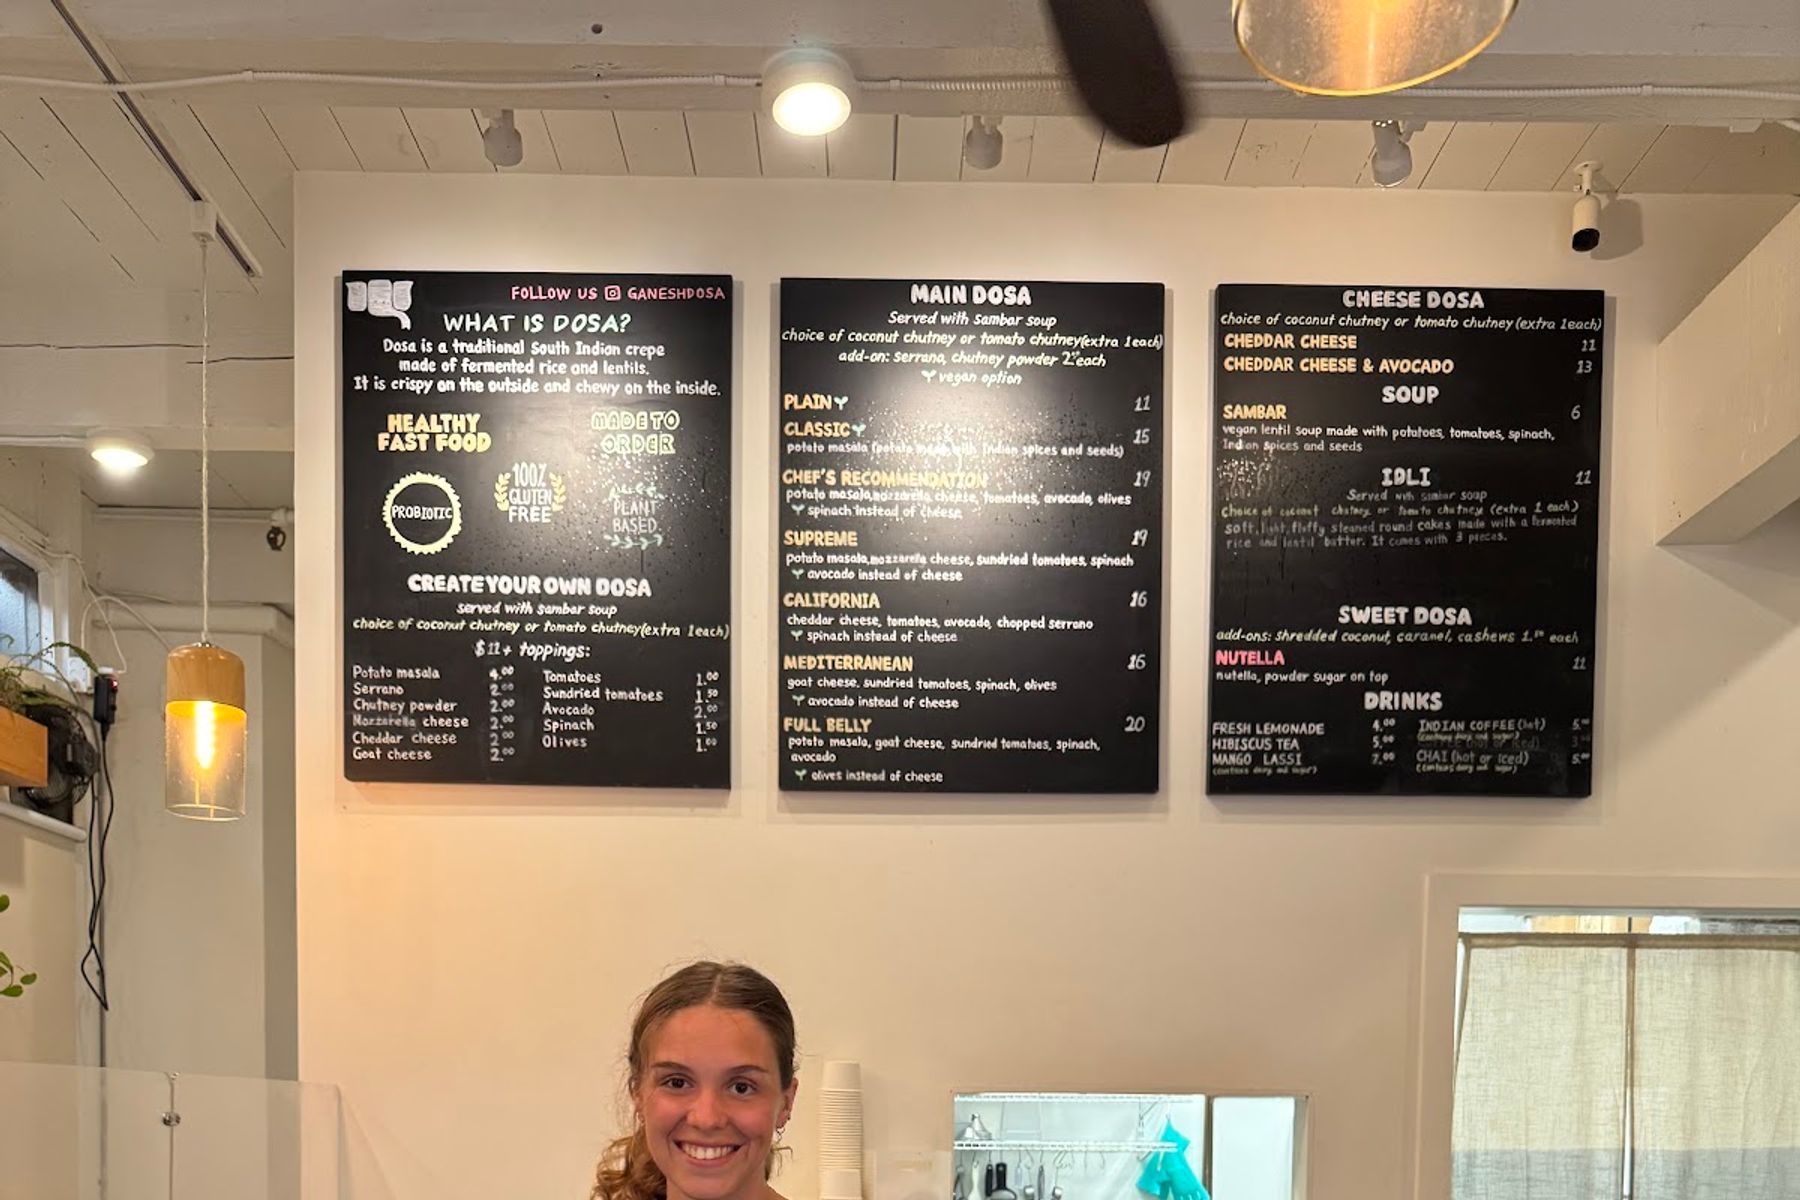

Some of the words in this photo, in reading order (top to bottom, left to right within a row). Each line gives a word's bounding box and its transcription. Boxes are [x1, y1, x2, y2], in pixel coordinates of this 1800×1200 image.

[512, 286, 571, 300] FOLLOW
[578, 288, 597, 299] US
[628, 287, 725, 300] GANESHDOSA
[911, 284, 967, 303] MAIN
[973, 285, 1031, 305] DOSA
[1343, 290, 1420, 308] CHEESE
[1427, 291, 1484, 308] DOSA
[444, 313, 515, 332] WHAT
[524, 314, 543, 333] IS
[554, 314, 630, 333] DOSA?
[888, 311, 938, 324] Served
[941, 311, 969, 325] with
[1025, 316, 1056, 330] soup
[383, 339, 416, 352] Dosa
[421, 338, 432, 353] is
[438, 343, 448, 353] a
[452, 338, 524, 355] traditional
[531, 341, 570, 355] South
[575, 341, 620, 356] Indian
[625, 345, 665, 360] crepe
[1225, 334, 1294, 348] CHEDDAR
[1301, 335, 1356, 348] CHEESE
[1582, 339, 1596, 351] 11
[399, 358, 436, 372] made
[441, 357, 458, 372] of
[461, 358, 535, 374] fermented
[539, 360, 567, 374] rice
[571, 360, 597, 375] and
[603, 360, 649, 375] lentils.
[1224, 357, 1293, 371] CHEDDAR
[1300, 358, 1356, 372] CHEESE
[1363, 358, 1373, 372] &
[1379, 359, 1453, 373] AVOCADO
[1577, 360, 1592, 373] 13
[354, 375, 368, 390] It
[374, 376, 386, 390] is
[391, 377, 433, 394] crispy
[437, 380, 455, 392] on
[459, 377, 484, 392] the
[488, 377, 539, 393] outside
[544, 378, 570, 394] and
[575, 379, 620, 397] chewy
[625, 383, 642, 395] on
[646, 380, 670, 394] the
[676, 380, 720, 395] inside.
[940, 373, 977, 387] vegan
[981, 371, 1022, 387] option
[785, 394, 831, 410] PLAIN
[1382, 386, 1439, 403] SOUP
[1135, 395, 1150, 411] 11
[1223, 405, 1286, 419] SAMBAR
[1571, 405, 1580, 419] 6
[388, 413, 480, 435] HEALTHY
[589, 411, 647, 433] MADE
[650, 410, 680, 430] TO
[785, 422, 850, 437] CLASSIC
[1133, 429, 1149, 444] 15
[1223, 426, 1257, 437] vegan
[1262, 424, 1290, 435] lentil
[1296, 426, 1322, 438] soup
[1327, 425, 1358, 436] made
[1363, 425, 1388, 436] with
[1393, 425, 1444, 440] potatoes,
[1508, 428, 1554, 442] spinach,
[378, 432, 429, 451] FAST
[436, 432, 491, 452] FOOD
[599, 432, 675, 456] ORDER
[1263, 440, 1299, 456] spices
[1304, 440, 1324, 451] and
[1329, 441, 1362, 452] seeds
[512, 461, 547, 487] 100%
[783, 468, 836, 485] CHEF'S
[842, 468, 989, 490] RECOMMENDATION
[1134, 471, 1150, 486] 19
[1382, 468, 1430, 486] IDLI
[1575, 470, 1591, 485] 11
[509, 489, 552, 505] GLUTEN
[390, 503, 452, 521] PROBIOTIC
[507, 506, 553, 523] FREE
[611, 499, 658, 516] PLANT
[612, 516, 657, 534] BASED
[784, 531, 857, 546] SUPREME
[1132, 530, 1148, 546] 19
[808, 568, 855, 579] avocado
[859, 568, 900, 580] instead
[904, 569, 918, 580] of
[922, 569, 963, 581] cheese
[408, 574, 484, 593] CREATE
[485, 575, 541, 594] YOUR
[544, 577, 590, 595] OWN
[596, 578, 651, 596] DOSA
[784, 593, 880, 608] CALIFORNIA
[1130, 592, 1146, 607] 16
[457, 602, 501, 614] served
[505, 601, 533, 614] with
[537, 602, 585, 615] sambar
[588, 605, 617, 618] soup
[1339, 606, 1408, 624] SWEET
[1415, 607, 1471, 625] DOSA
[787, 613, 834, 625] cheddar
[944, 616, 992, 629] avocado,
[997, 616, 1045, 631] chopped
[1049, 620, 1093, 629] serrano
[520, 642, 590, 662] toppings:
[1216, 650, 1284, 665] NUTELLA
[784, 655, 913, 671] MEDITERRANEAN
[1128, 655, 1145, 669] 16
[1573, 657, 1585, 669] 11
[353, 665, 392, 678] Potato
[397, 667, 440, 678] masala
[543, 670, 601, 683] Tomatoes
[1217, 670, 1261, 683] nutella,
[1265, 670, 1309, 684] powder
[1314, 673, 1346, 685] sugar
[1351, 673, 1365, 681] on
[1370, 671, 1388, 685] top
[353, 682, 404, 695] Serrano
[544, 686, 599, 699] Sundried
[605, 688, 663, 701] tomatoes
[353, 698, 405, 715] Chutney
[410, 699, 457, 713] powder
[543, 702, 594, 715] Avocado
[1365, 691, 1442, 710] DRINKS
[544, 718, 594, 733] Spinach
[784, 717, 821, 732] FULL
[827, 718, 871, 732] BELLY
[1125, 716, 1145, 732] 20
[1213, 722, 1251, 734] FRESH
[1256, 723, 1324, 734] LEMONADE
[353, 731, 403, 744] Cheddar
[412, 732, 456, 744] cheese
[1213, 738, 1271, 751] HIBISCUS
[1276, 738, 1299, 750] TEA
[353, 747, 381, 759] Goat
[387, 748, 432, 760] cheese
[1213, 753, 1251, 765] MANGO
[1264, 753, 1301, 765] LASSI
[812, 771, 842, 780] olives
[846, 770, 885, 781] instead
[890, 770, 901, 781] of
[905, 771, 942, 782] cheese
